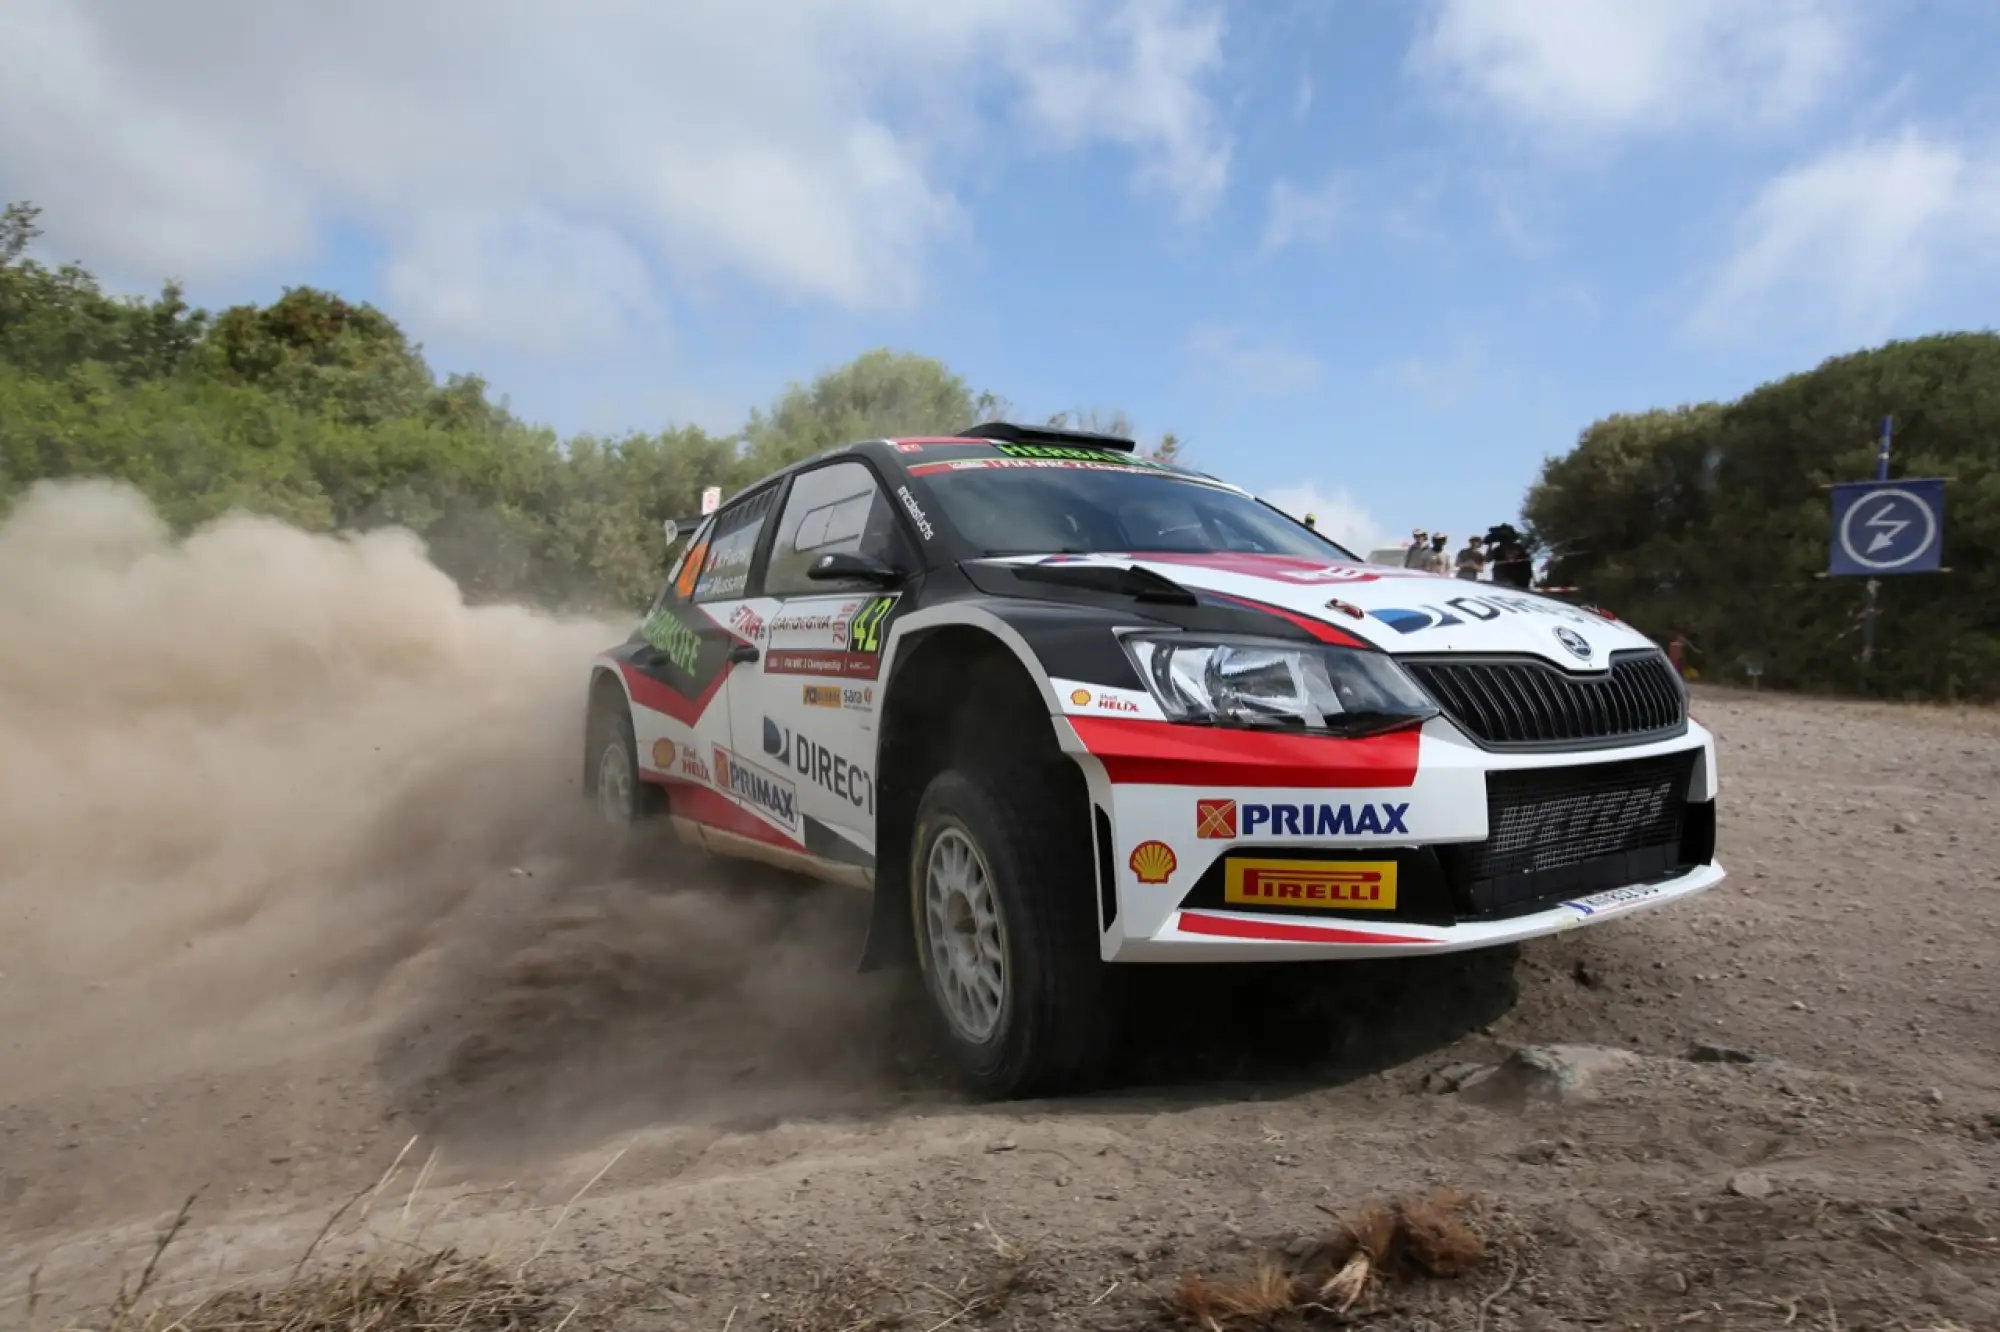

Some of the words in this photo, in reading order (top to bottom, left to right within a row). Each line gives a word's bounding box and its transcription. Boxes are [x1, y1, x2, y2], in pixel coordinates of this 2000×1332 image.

[832, 603, 858, 645] 2016
[852, 597, 893, 651] 42
[1098, 699, 1140, 713] HELIX
[683, 758, 711, 783] HELIX
[730, 760, 795, 823] PRIMAX
[1242, 802, 1410, 835] PRIMAX
[1243, 867, 1382, 901] PIRELLI
